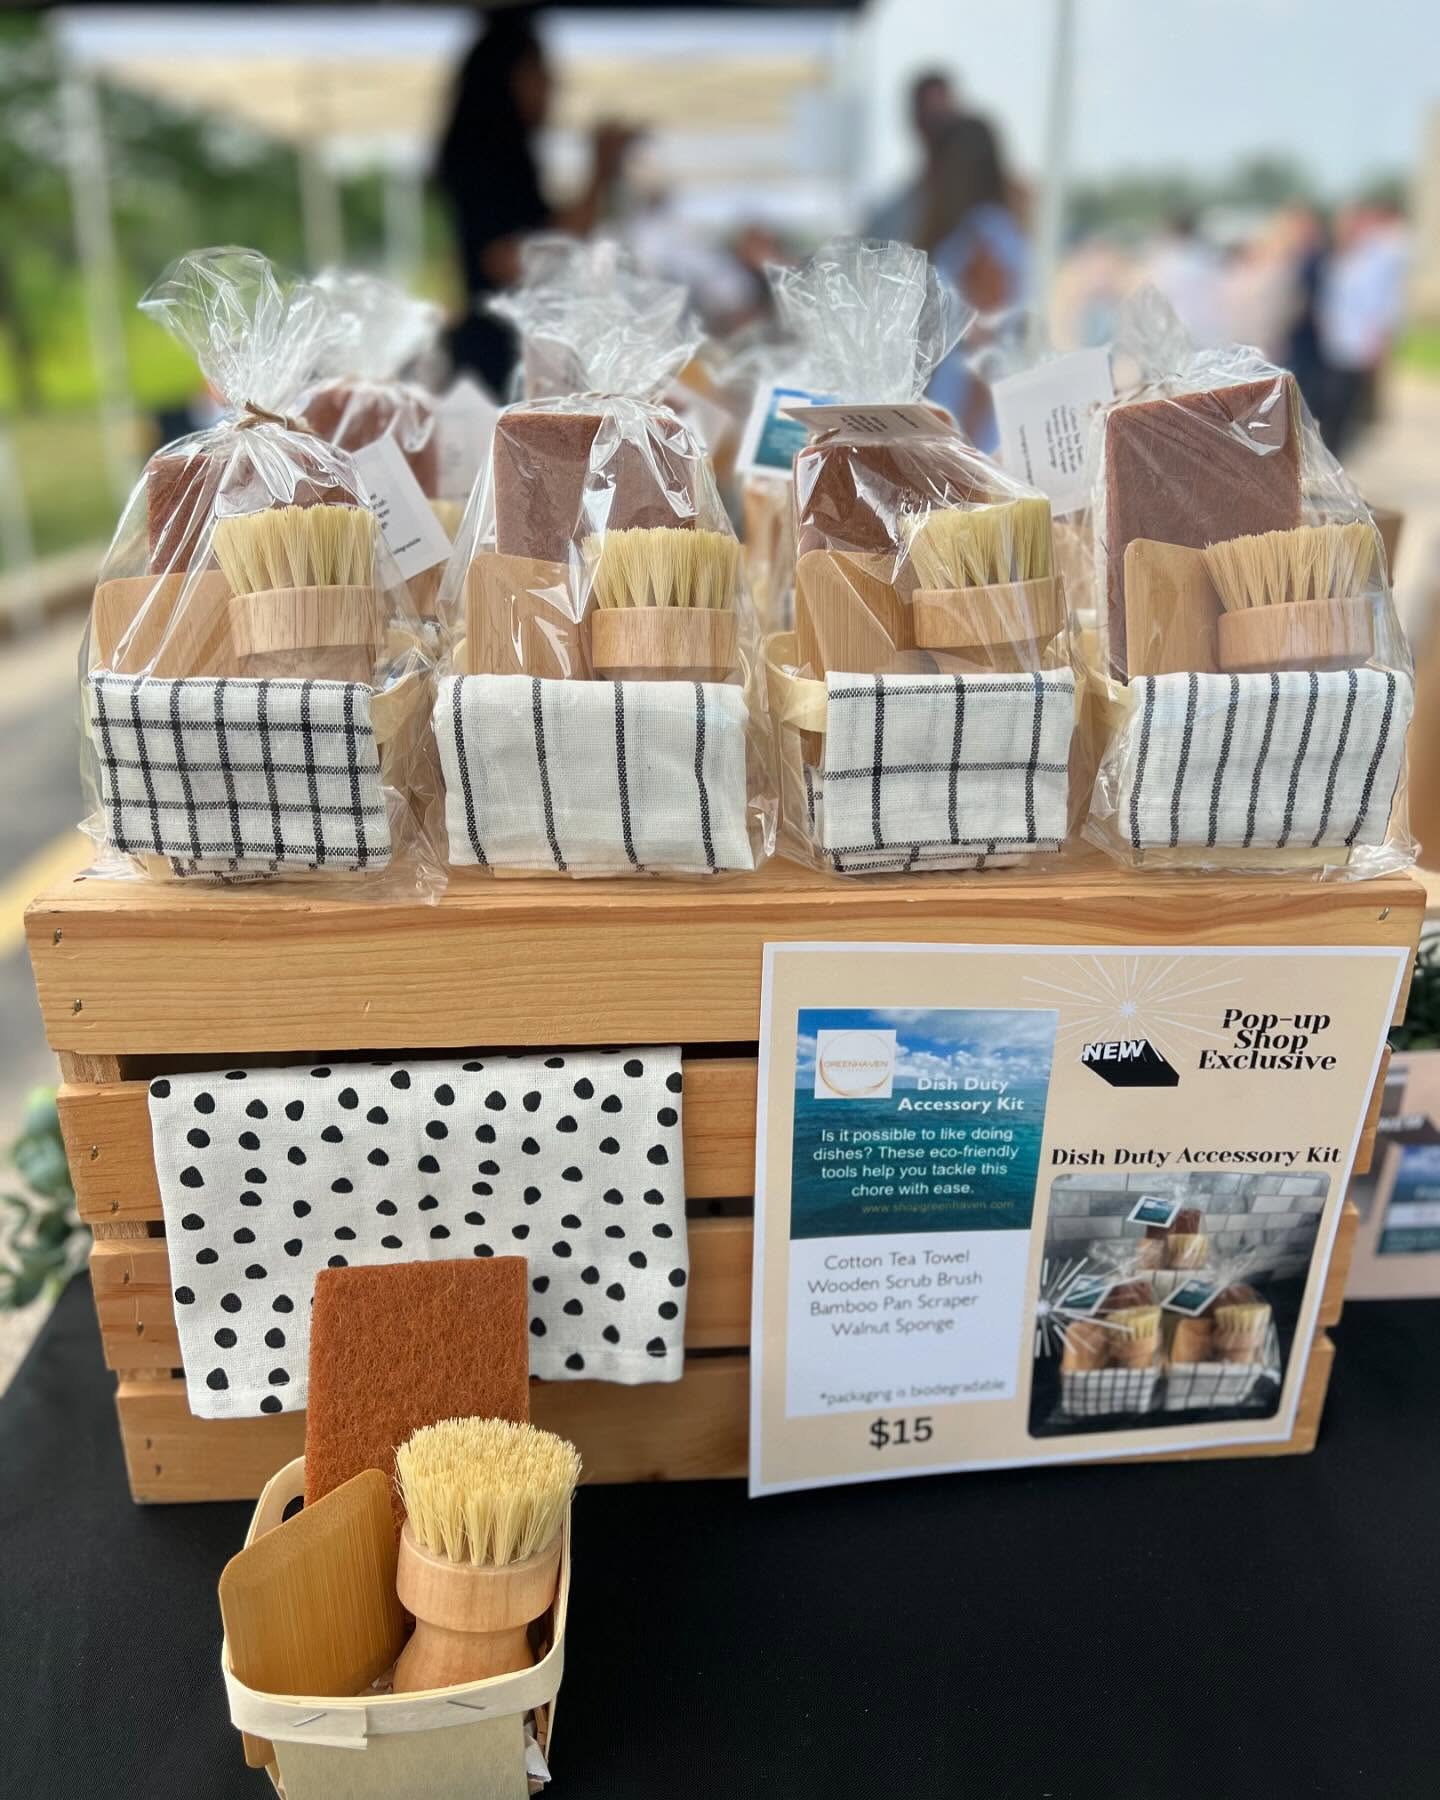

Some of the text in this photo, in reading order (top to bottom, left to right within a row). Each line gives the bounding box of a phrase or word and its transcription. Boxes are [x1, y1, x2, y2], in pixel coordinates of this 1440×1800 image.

[1222, 1008, 1331, 1033] Pop-up
[1233, 1029, 1309, 1053] Shop
[1199, 1050, 1337, 1071] Exclusive
[917, 1077, 1009, 1094] Dish Duty
[898, 1096, 1024, 1114] Accessory Kit
[821, 1126, 1014, 1144] Is it possible to like doing
[813, 1145, 1020, 1161] dishes? These eco-friendly
[1051, 1146, 1342, 1168] Dish Duty Accessory Kit
[821, 1162, 1008, 1181] tools help you tackle this
[851, 1182, 975, 1197] chore with ease.
[861, 1199, 1015, 1214] wwwshopgreenhavencom
[824, 1249, 970, 1270] Cotton Tea Towel
[807, 1270, 983, 1294] Wooden Scrub Brush
[810, 1293, 979, 1317] Bamboo Pan Scraper
[831, 1317, 955, 1337] Walnut Sponge
[910, 1379, 1006, 1397] biodegradable
[869, 1416, 933, 1450] $15
